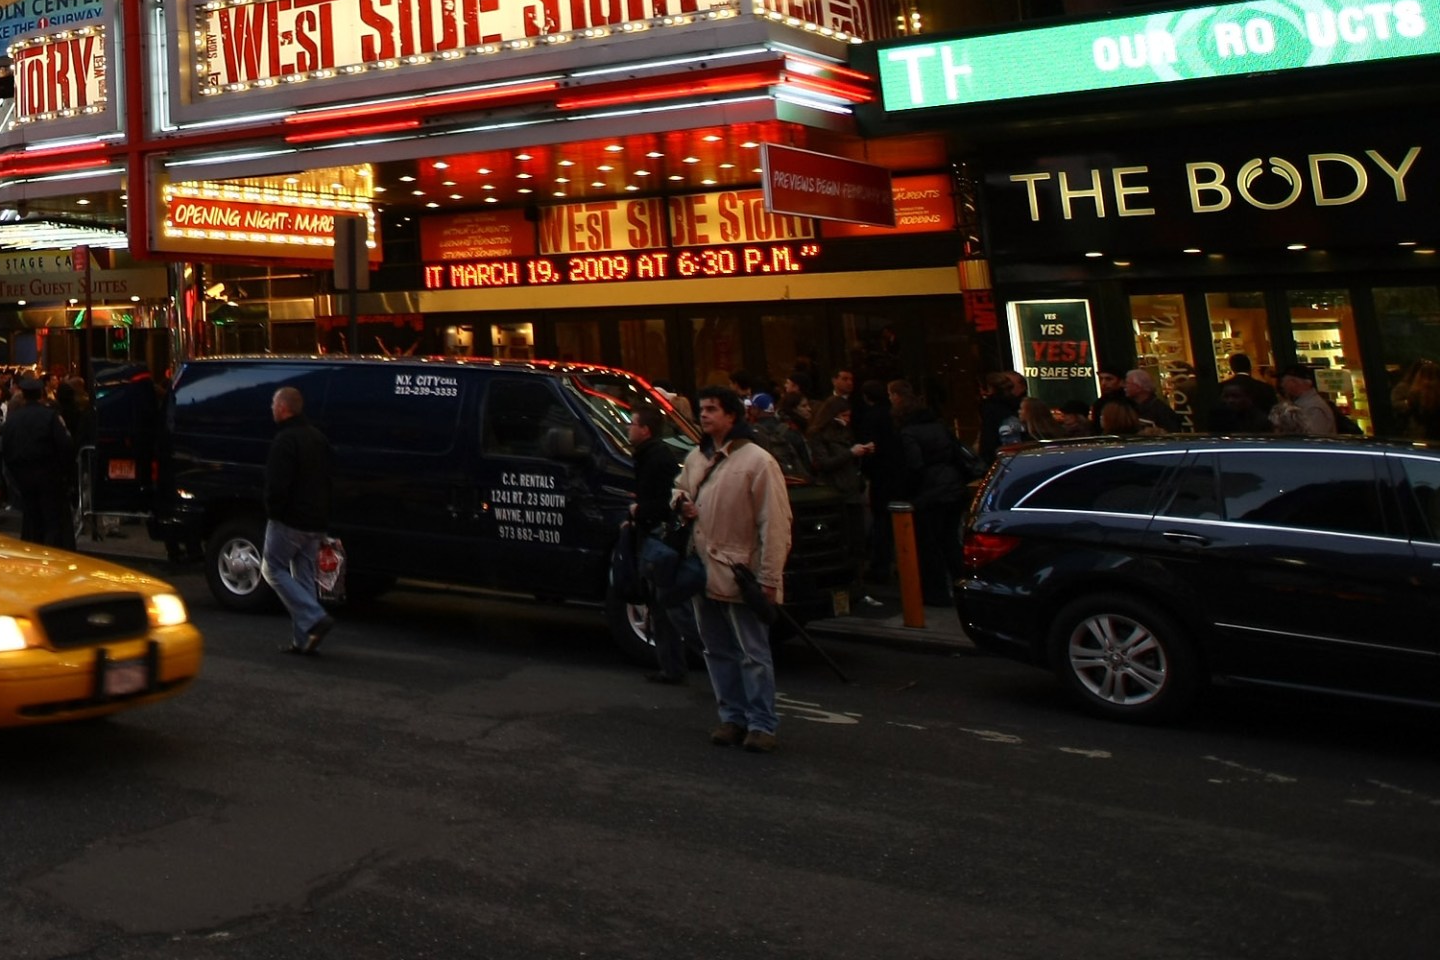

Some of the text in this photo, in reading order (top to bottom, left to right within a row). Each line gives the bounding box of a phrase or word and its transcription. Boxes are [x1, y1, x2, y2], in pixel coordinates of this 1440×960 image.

[1092, 32, 1176, 72] OUR
[773, 170, 815, 193] PREVIEWS
[1009, 146, 1422, 222] THE BODY
[175, 204, 242, 227] OPENING
[244, 210, 292, 231] NIGHT:
[539, 195, 710, 254] WEST SIDE
[6, 255, 44, 270] STAGE
[450, 250, 736, 288] MARCH 19, 2009 AT 6:30
[29, 278, 73, 297] GUEST
[1040, 324, 1064, 336] YES
[1031, 340, 1089, 365] YES!
[416, 375, 441, 386] CITY
[440, 378, 458, 386] CALL
[1024, 366, 1092, 378] TO SAFE SEX
[502, 472, 555, 490] C.C. RENTALS
[491, 490, 566, 508] 1241 RT. 23 SOUTH
[494, 507, 525, 525] WAYNE,
[499, 525, 515, 540] 973
